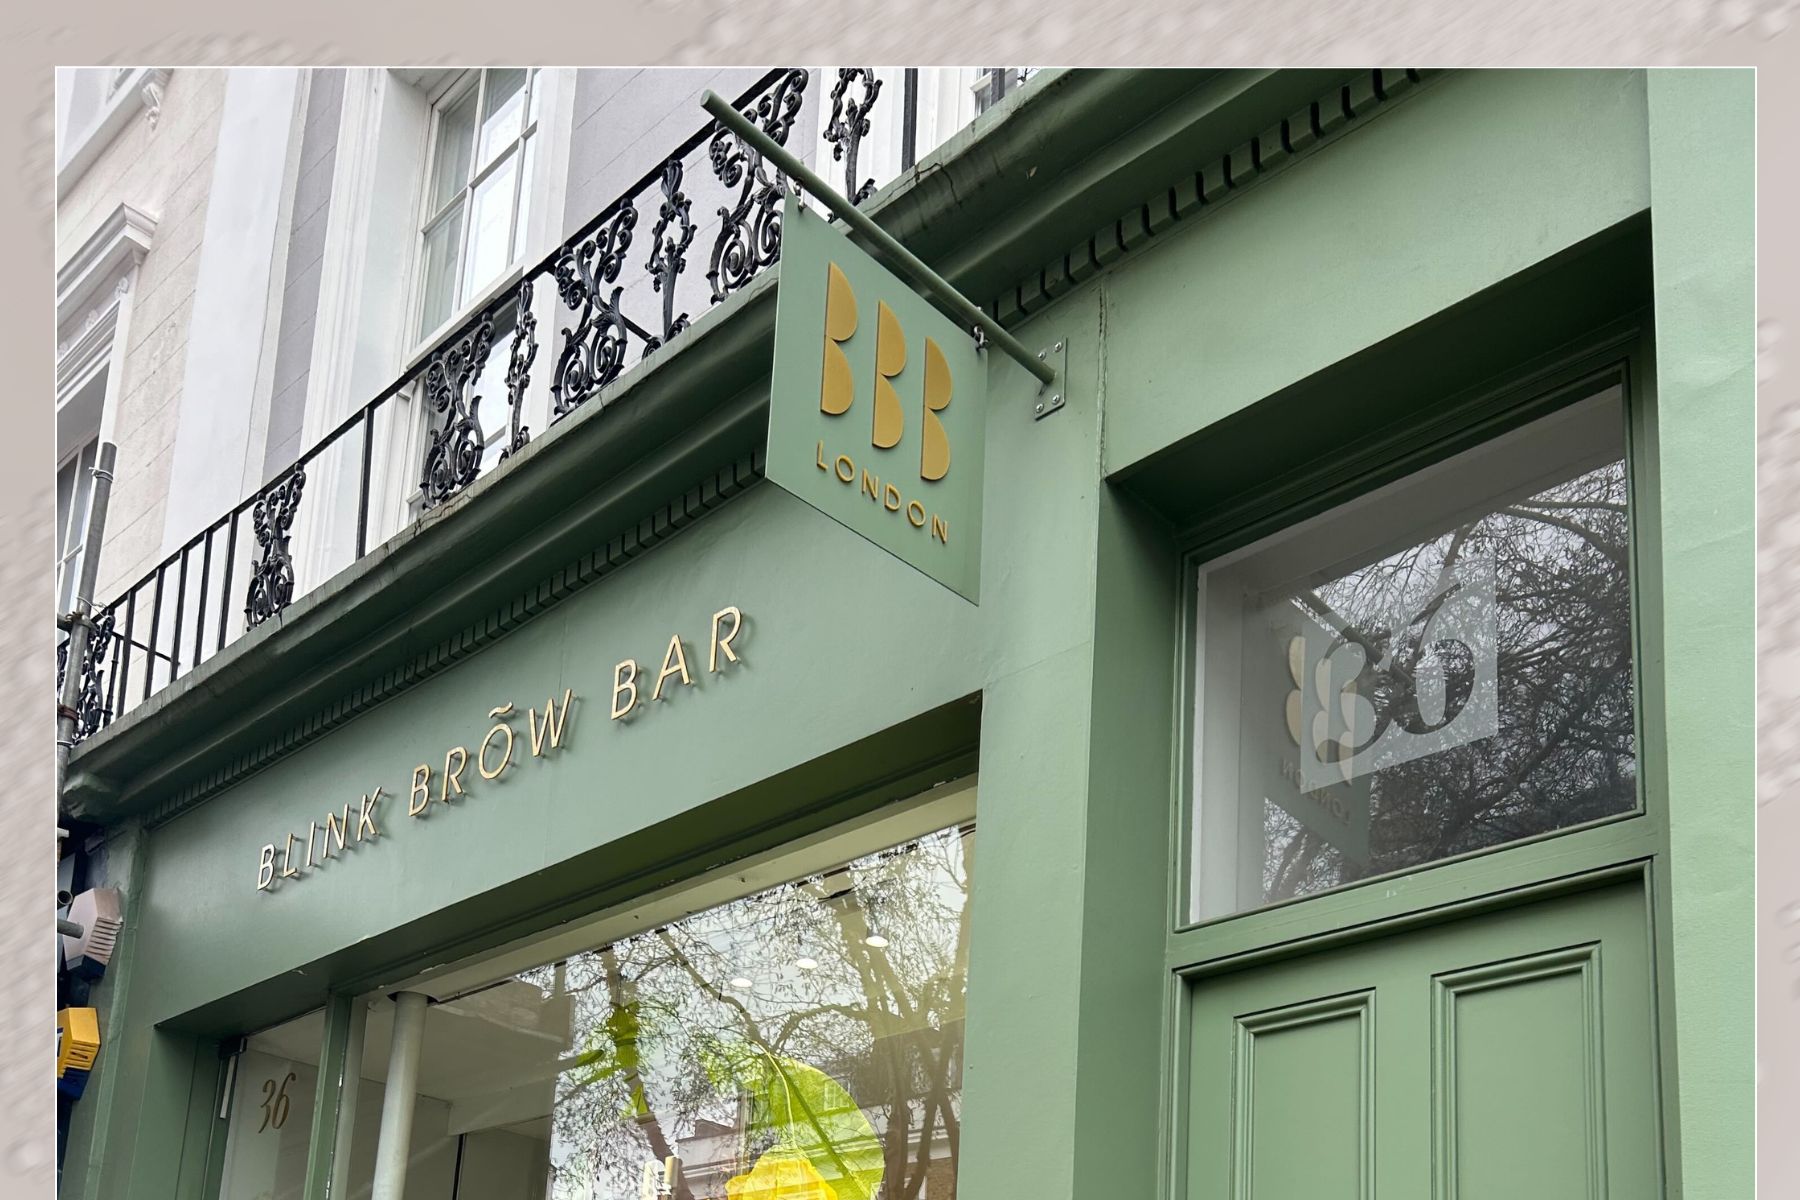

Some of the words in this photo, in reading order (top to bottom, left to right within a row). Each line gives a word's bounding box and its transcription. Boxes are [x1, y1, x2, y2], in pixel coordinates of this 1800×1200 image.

[820, 261, 953, 481] BBB
[817, 439, 948, 544] LONDON
[257, 786, 384, 890] BLINK
[611, 606, 742, 721] BAR
[258, 1072, 297, 1134] 36
